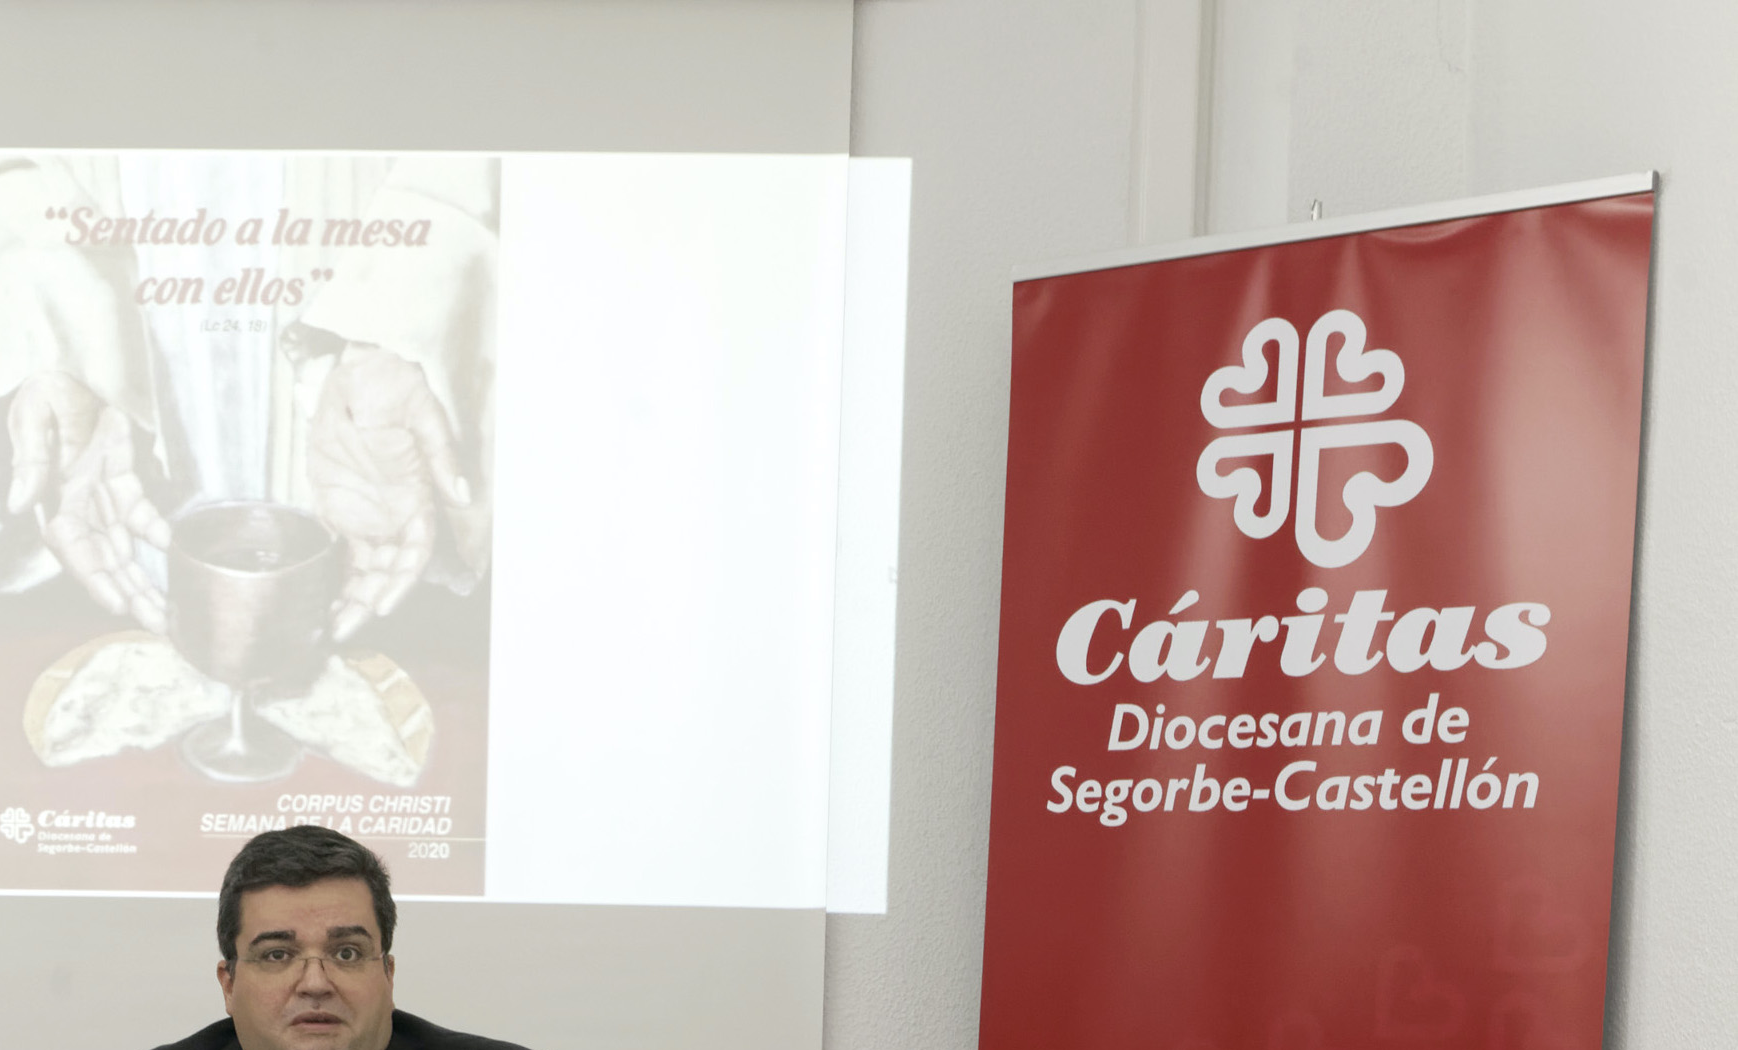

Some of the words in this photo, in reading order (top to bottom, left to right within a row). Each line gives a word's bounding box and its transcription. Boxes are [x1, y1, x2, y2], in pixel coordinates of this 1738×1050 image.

[45, 207, 226, 247] “Sentado
[236, 218, 263, 247] a
[273, 209, 311, 247] la
[321, 218, 431, 248] mesa
[135, 276, 202, 306] con
[212, 268, 333, 306] ellos”
[1056, 587, 1552, 686] Cáritas
[1107, 703, 1384, 751] Diocesana
[1402, 693, 1469, 744] de
[277, 794, 364, 813] CORPUS
[368, 795, 451, 814] CHRISTI
[1046, 756, 1539, 827] Segorbe-Castellón
[37, 810, 136, 828] Cáritas
[200, 814, 286, 832] SEMANA
[326, 817, 352, 834] LA
[358, 817, 452, 835] CARIDAD
[38, 832, 95, 842] Diocesana
[99, 832, 112, 842] de
[408, 842, 450, 858] 2020
